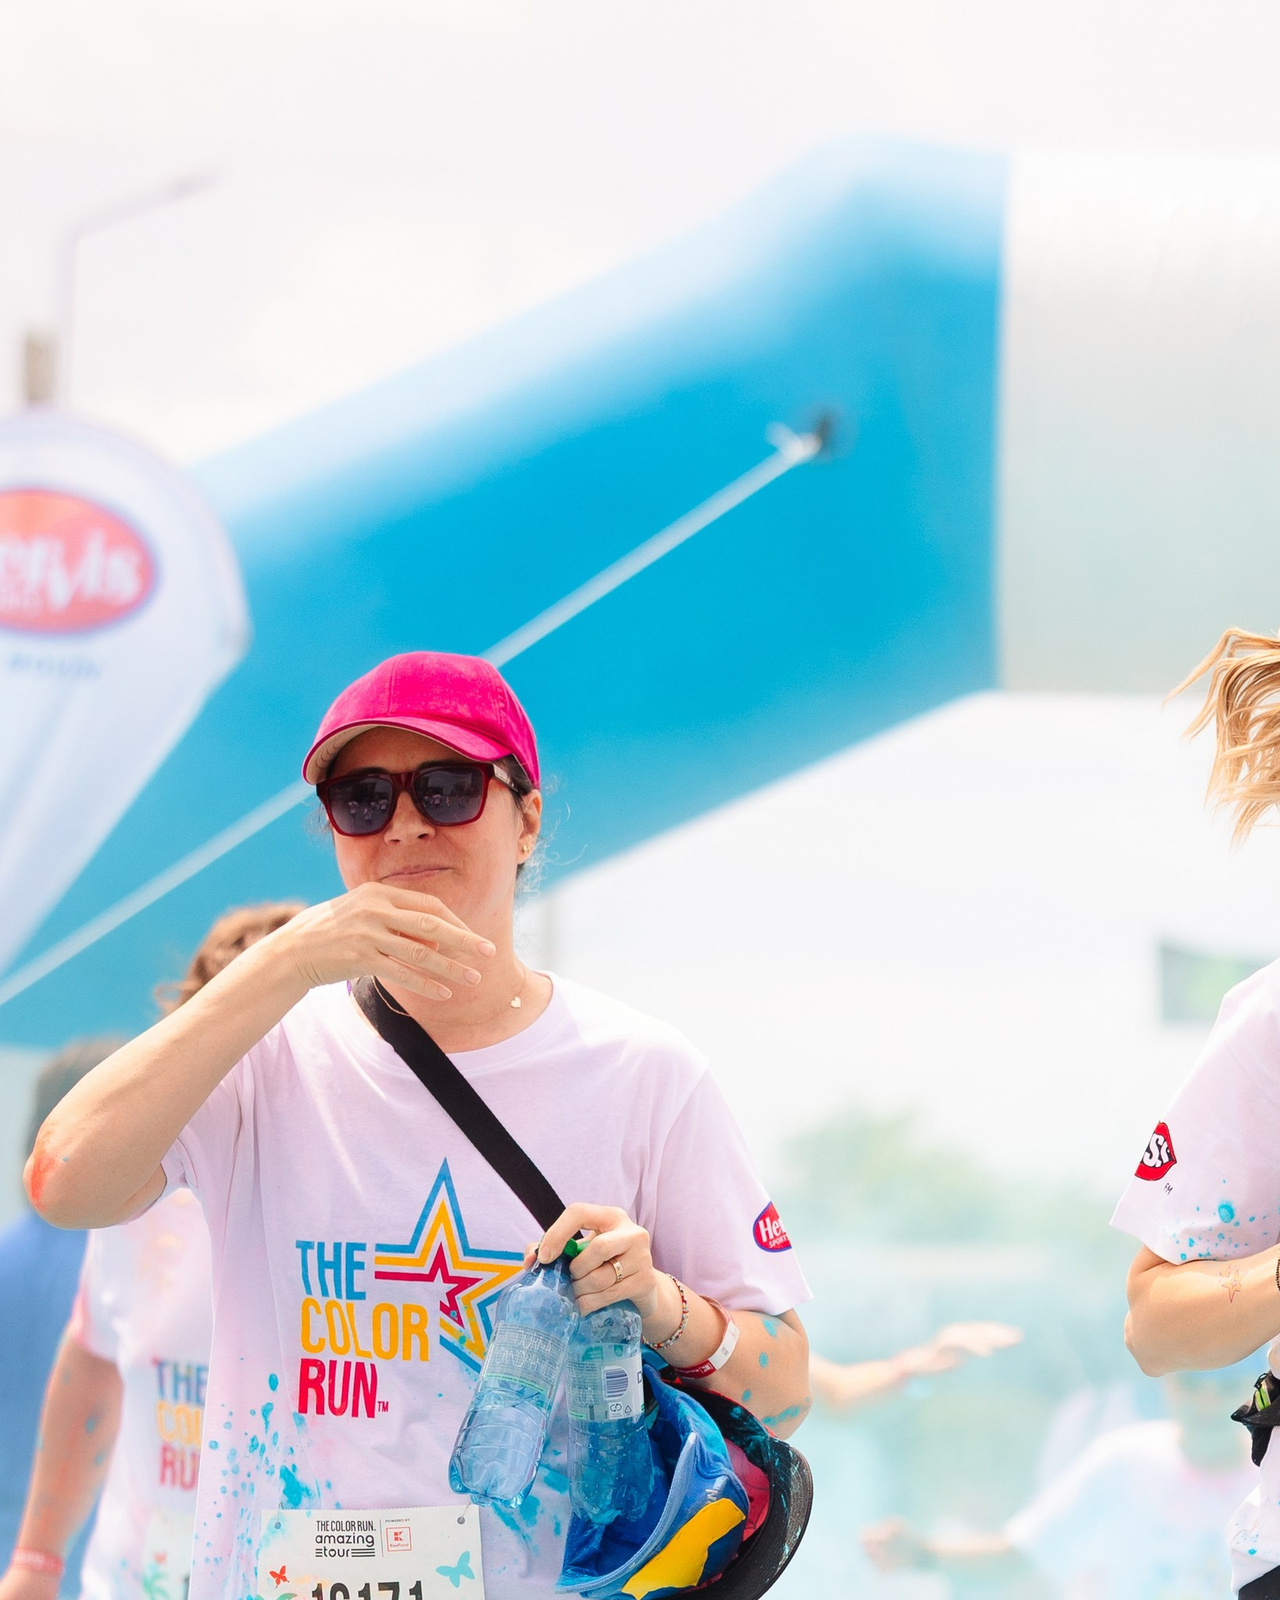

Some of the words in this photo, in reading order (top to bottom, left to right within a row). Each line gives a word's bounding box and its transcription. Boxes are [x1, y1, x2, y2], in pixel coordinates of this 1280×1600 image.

[295, 1239, 368, 1301] THE
[300, 1296, 430, 1363] COLOR
[160, 1442, 199, 1491] RU
[315, 1532, 375, 1548] amazing
[316, 1520, 330, 1532] THE
[330, 1520, 356, 1532] COLOR
[323, 1545, 350, 1558] tour
